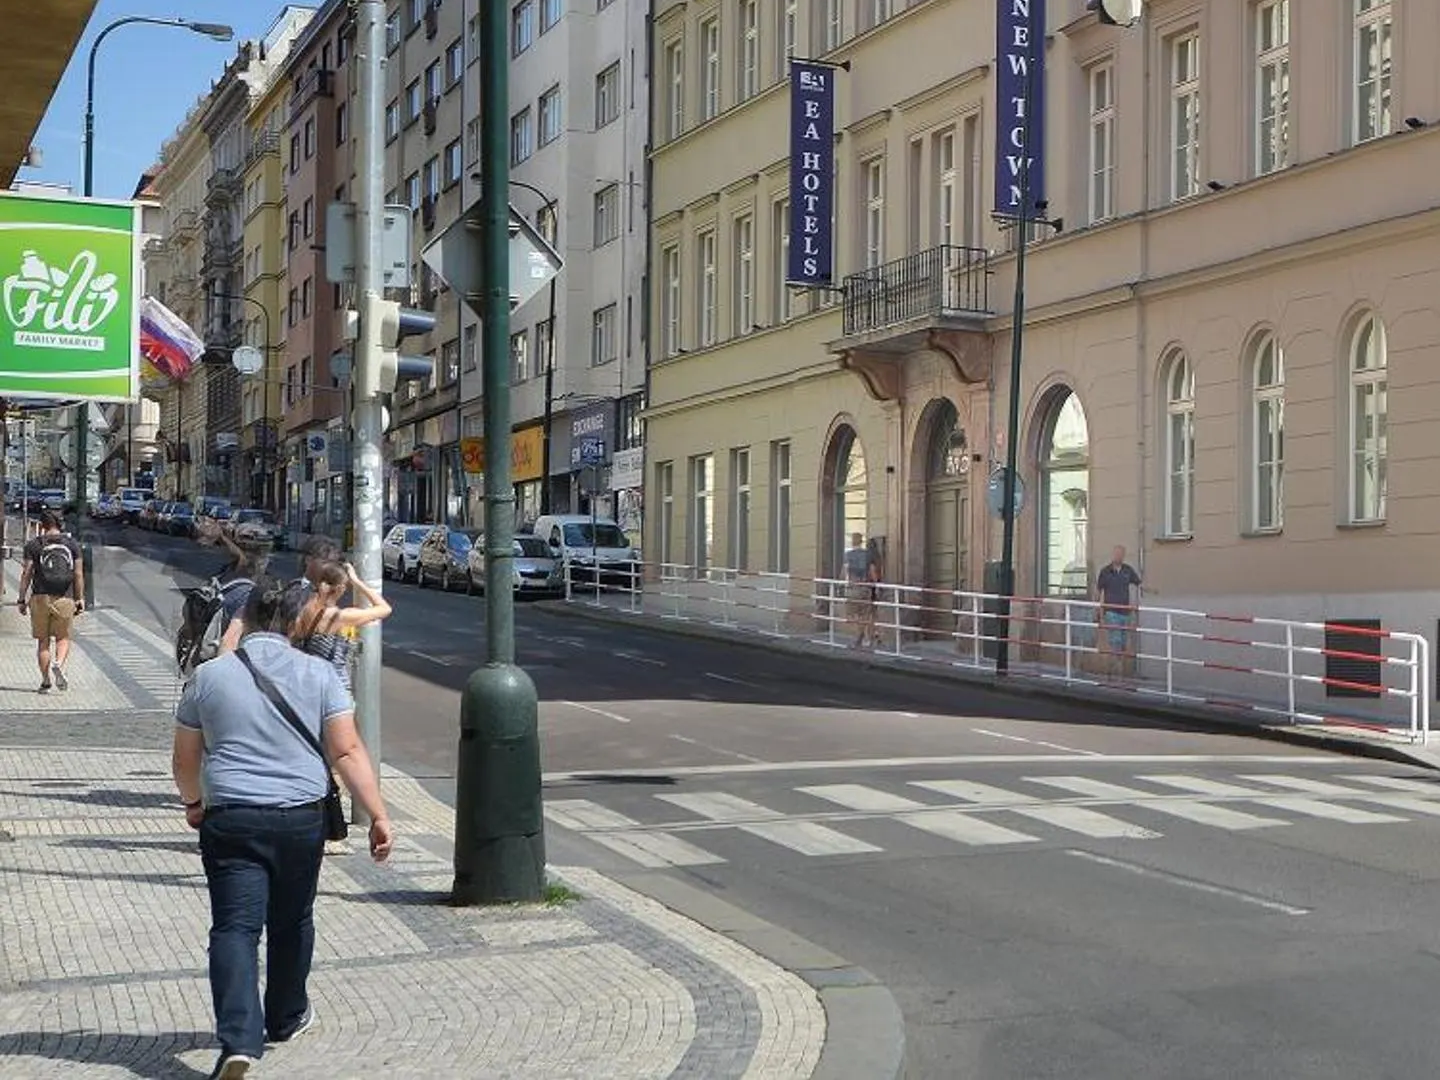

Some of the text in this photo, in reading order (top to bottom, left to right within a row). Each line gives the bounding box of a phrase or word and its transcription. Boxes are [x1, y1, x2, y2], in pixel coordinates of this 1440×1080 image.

[804, 100, 820, 140] EA
[802, 151, 821, 276] HOTELS
[3, 249, 119, 332] Fili
[19, 333, 100, 348] FAMILY MARKET
